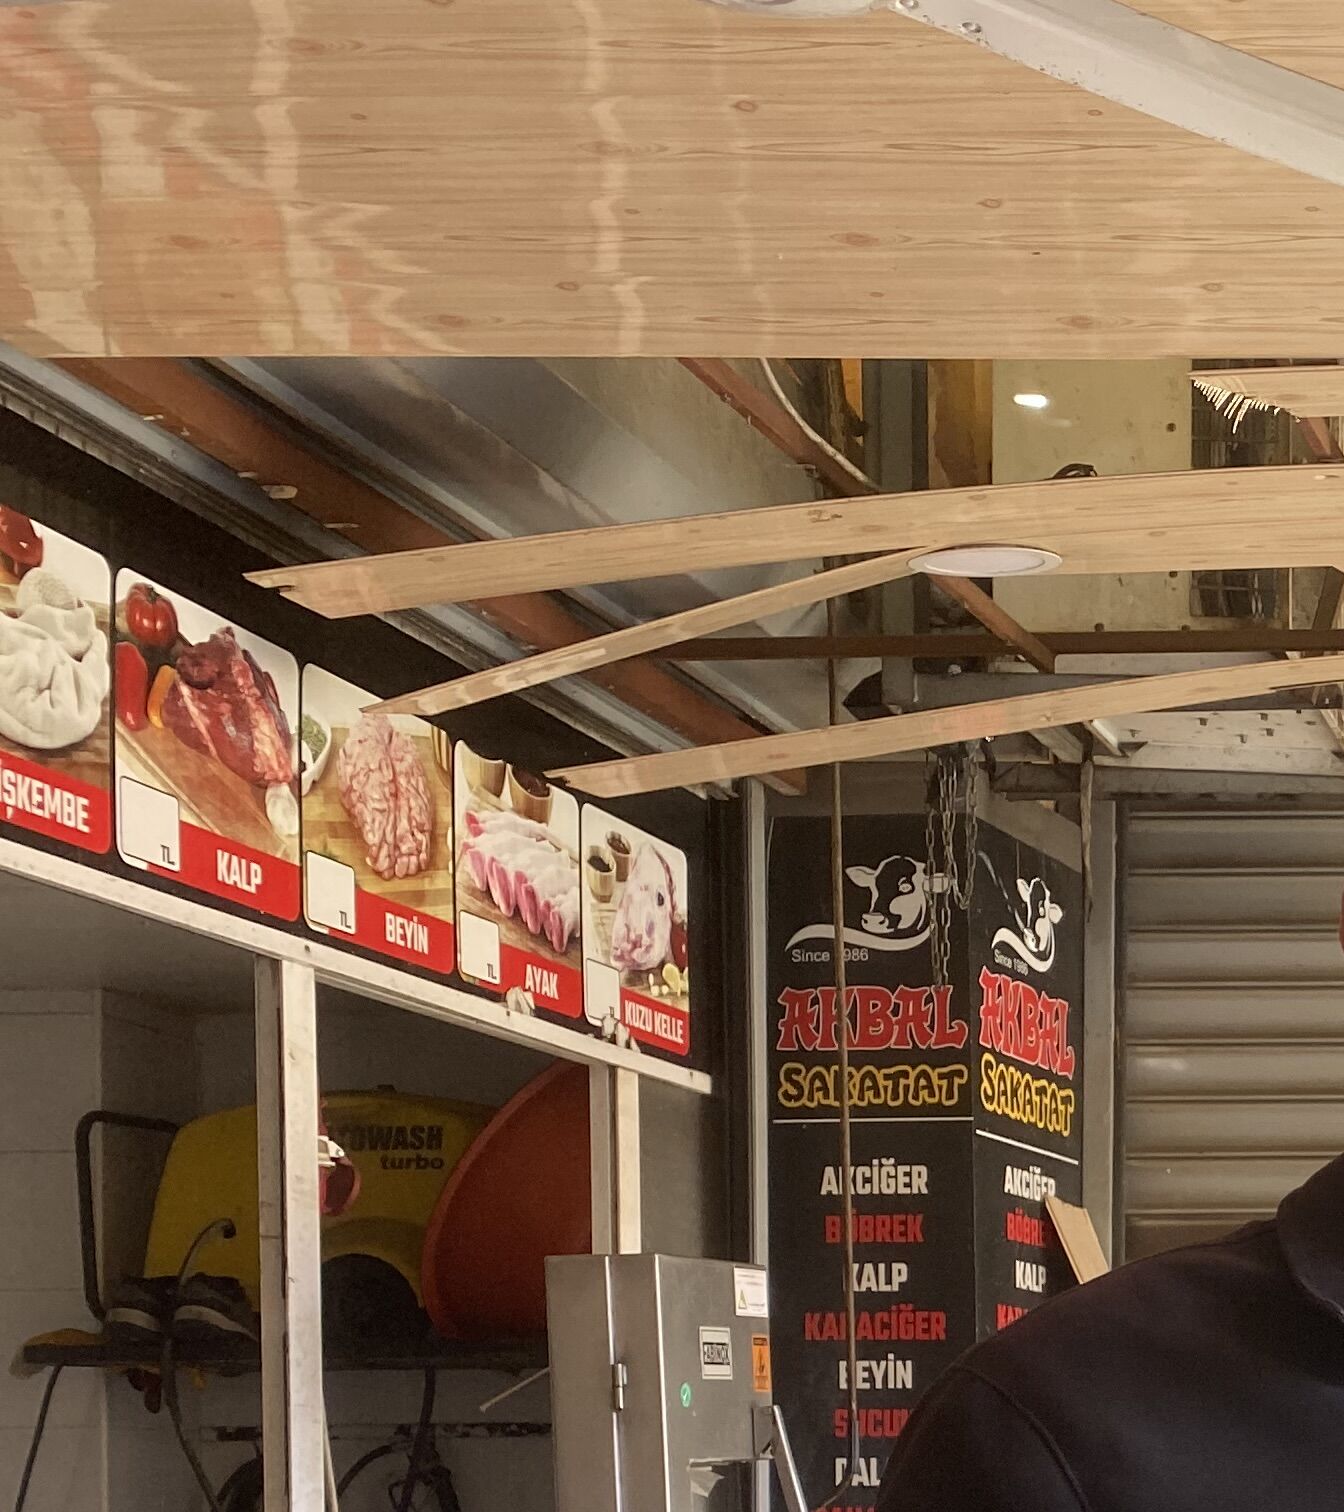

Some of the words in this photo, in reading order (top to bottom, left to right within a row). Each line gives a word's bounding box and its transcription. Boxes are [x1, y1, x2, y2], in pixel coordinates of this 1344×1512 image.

[160, 844, 175, 866] TL
[215, 848, 263, 894] KALP
[340, 910, 352, 929] TL
[384, 911, 430, 955] BEYİN
[791, 949, 831, 963] Since
[832, 948, 869, 962] 986
[524, 964, 559, 1000] AYAK
[624, 999, 653, 1033] KUZU
[653, 1009, 684, 1045] KELLE
[776, 985, 969, 1050] AKBAL
[979, 965, 1076, 1080] AKBAL
[778, 1062, 968, 1108] SAKATAT
[980, 1052, 1075, 1137] SAKATAT
[380, 1153, 445, 1170] turbo
[1004, 1165, 1056, 1202] AKCİĞER
[1006, 1207, 1047, 1248] BÖBRE
[1015, 1259, 1047, 1293] KALP
[834, 1409, 910, 1438] SCU
